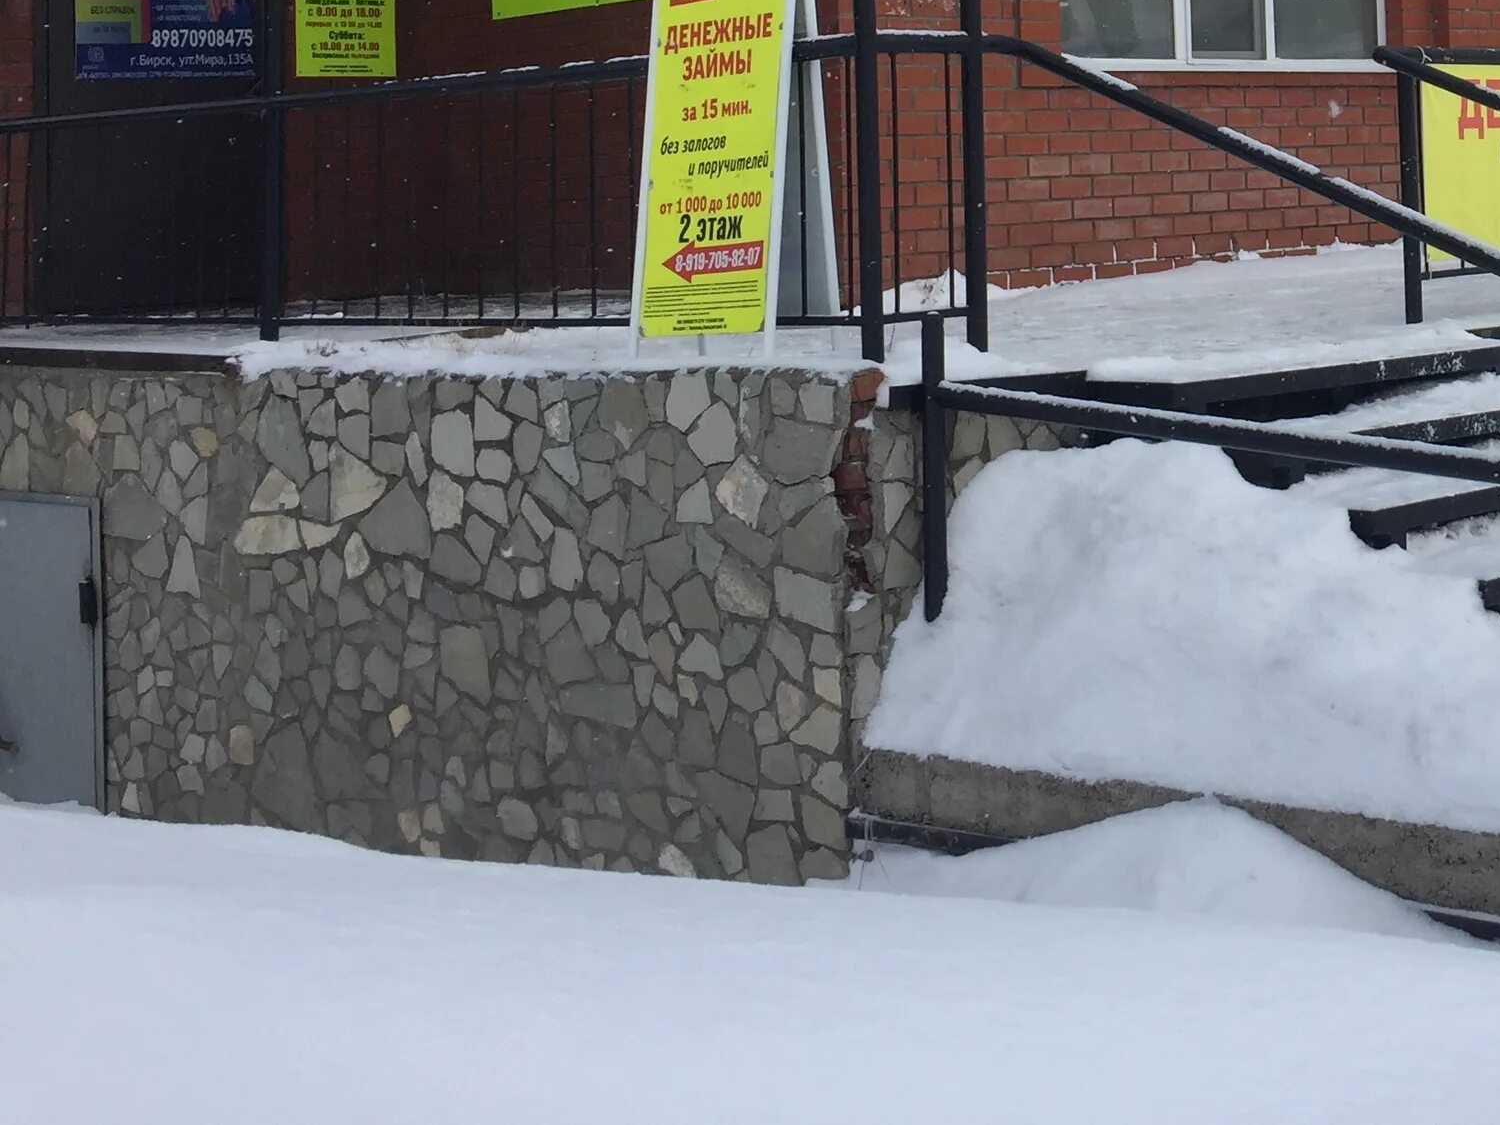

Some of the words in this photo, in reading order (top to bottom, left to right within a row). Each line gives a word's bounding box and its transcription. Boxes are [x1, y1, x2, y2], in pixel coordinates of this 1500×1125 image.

[152, 29, 253, 47] 89870908475
[664, 12, 773, 55] ДЕНЕЖНЫЕ
[682, 48, 752, 81] ЗАЙМЫ
[682, 106, 697, 122] за
[701, 98, 718, 120] 15
[721, 100, 752, 117] мин.
[660, 135, 679, 155] без
[681, 136, 726, 153] залогов
[688, 164, 694, 176] и
[697, 150, 769, 179] поручителей
[660, 202, 673, 215] от
[685, 195, 706, 213] 000
[709, 200, 723, 213] до
[726, 195, 739, 210] 10
[741, 191, 762, 208] 000
[678, 213, 691, 244] 2
[696, 214, 744, 242] этаж
[675, 246, 761, 273] 8-919-705-82-07
